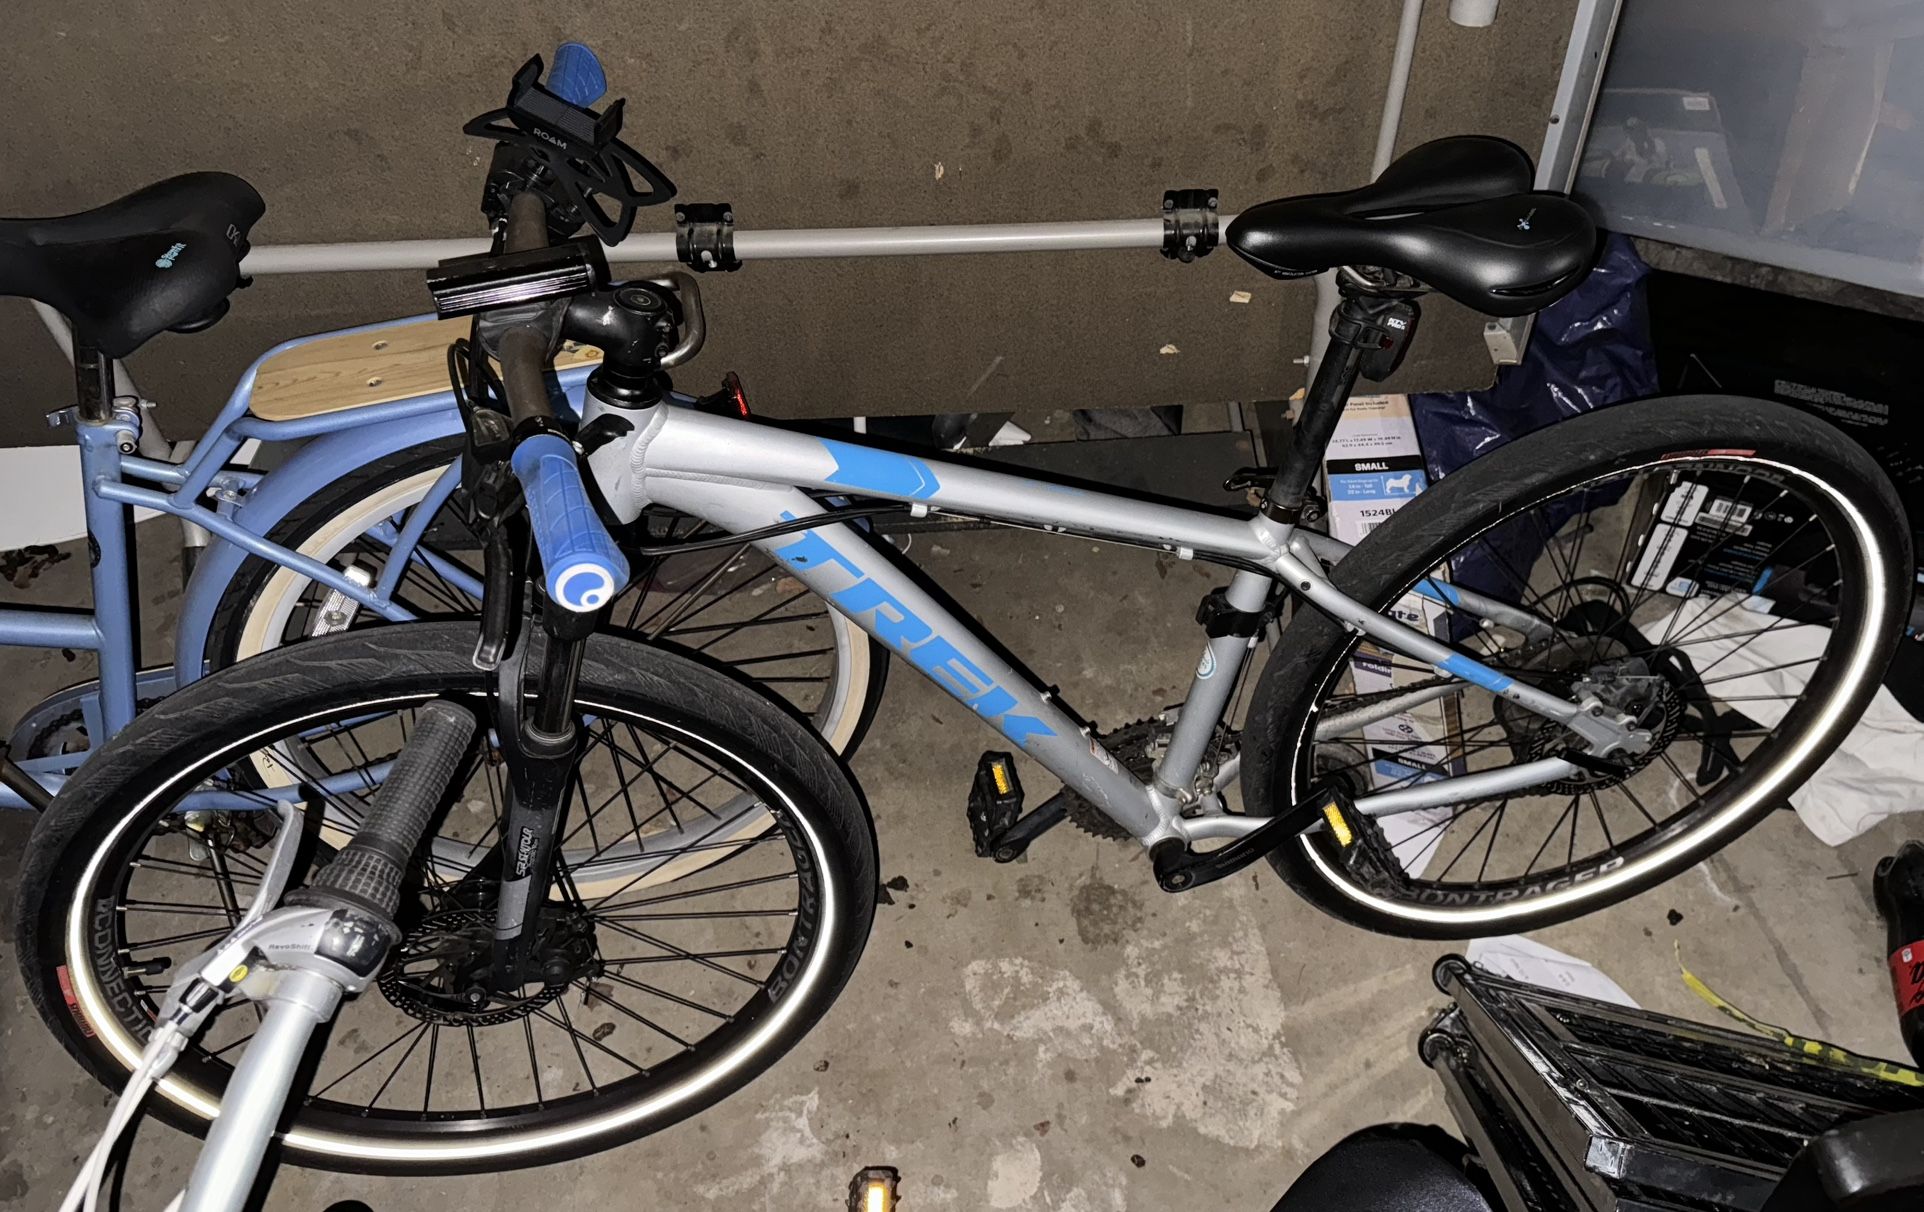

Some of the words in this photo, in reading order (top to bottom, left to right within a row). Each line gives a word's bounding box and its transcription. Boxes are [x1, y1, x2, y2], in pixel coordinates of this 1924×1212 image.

[533, 127, 567, 150] ROAM
[1354, 462, 1389, 471] SMALL
[775, 510, 1057, 747] TREK
[1397, 758, 1427, 770] SMALL
[519, 827, 534, 864] SUNTOUR
[94, 914, 155, 1044] CONNECTIO
